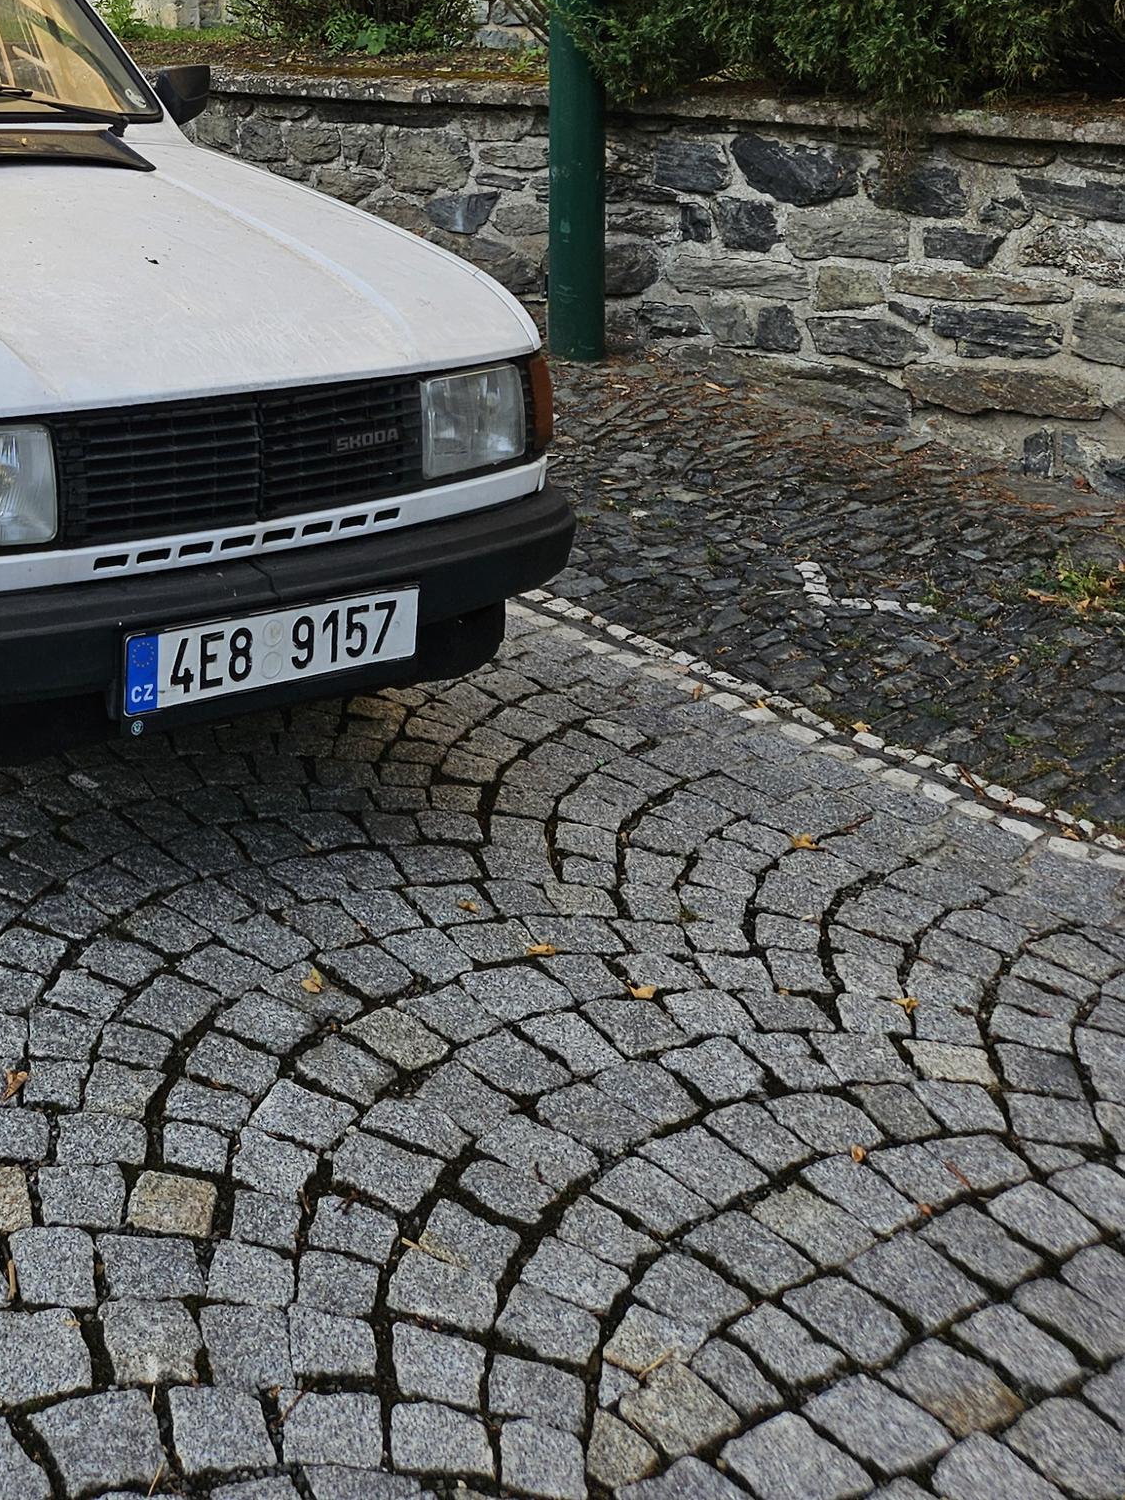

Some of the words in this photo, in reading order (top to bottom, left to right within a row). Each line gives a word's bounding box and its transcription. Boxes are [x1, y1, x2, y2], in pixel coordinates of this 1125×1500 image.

[169, 626, 254, 694] 4E8
[291, 599, 398, 671] 9157
[130, 683, 155, 704] CZ
